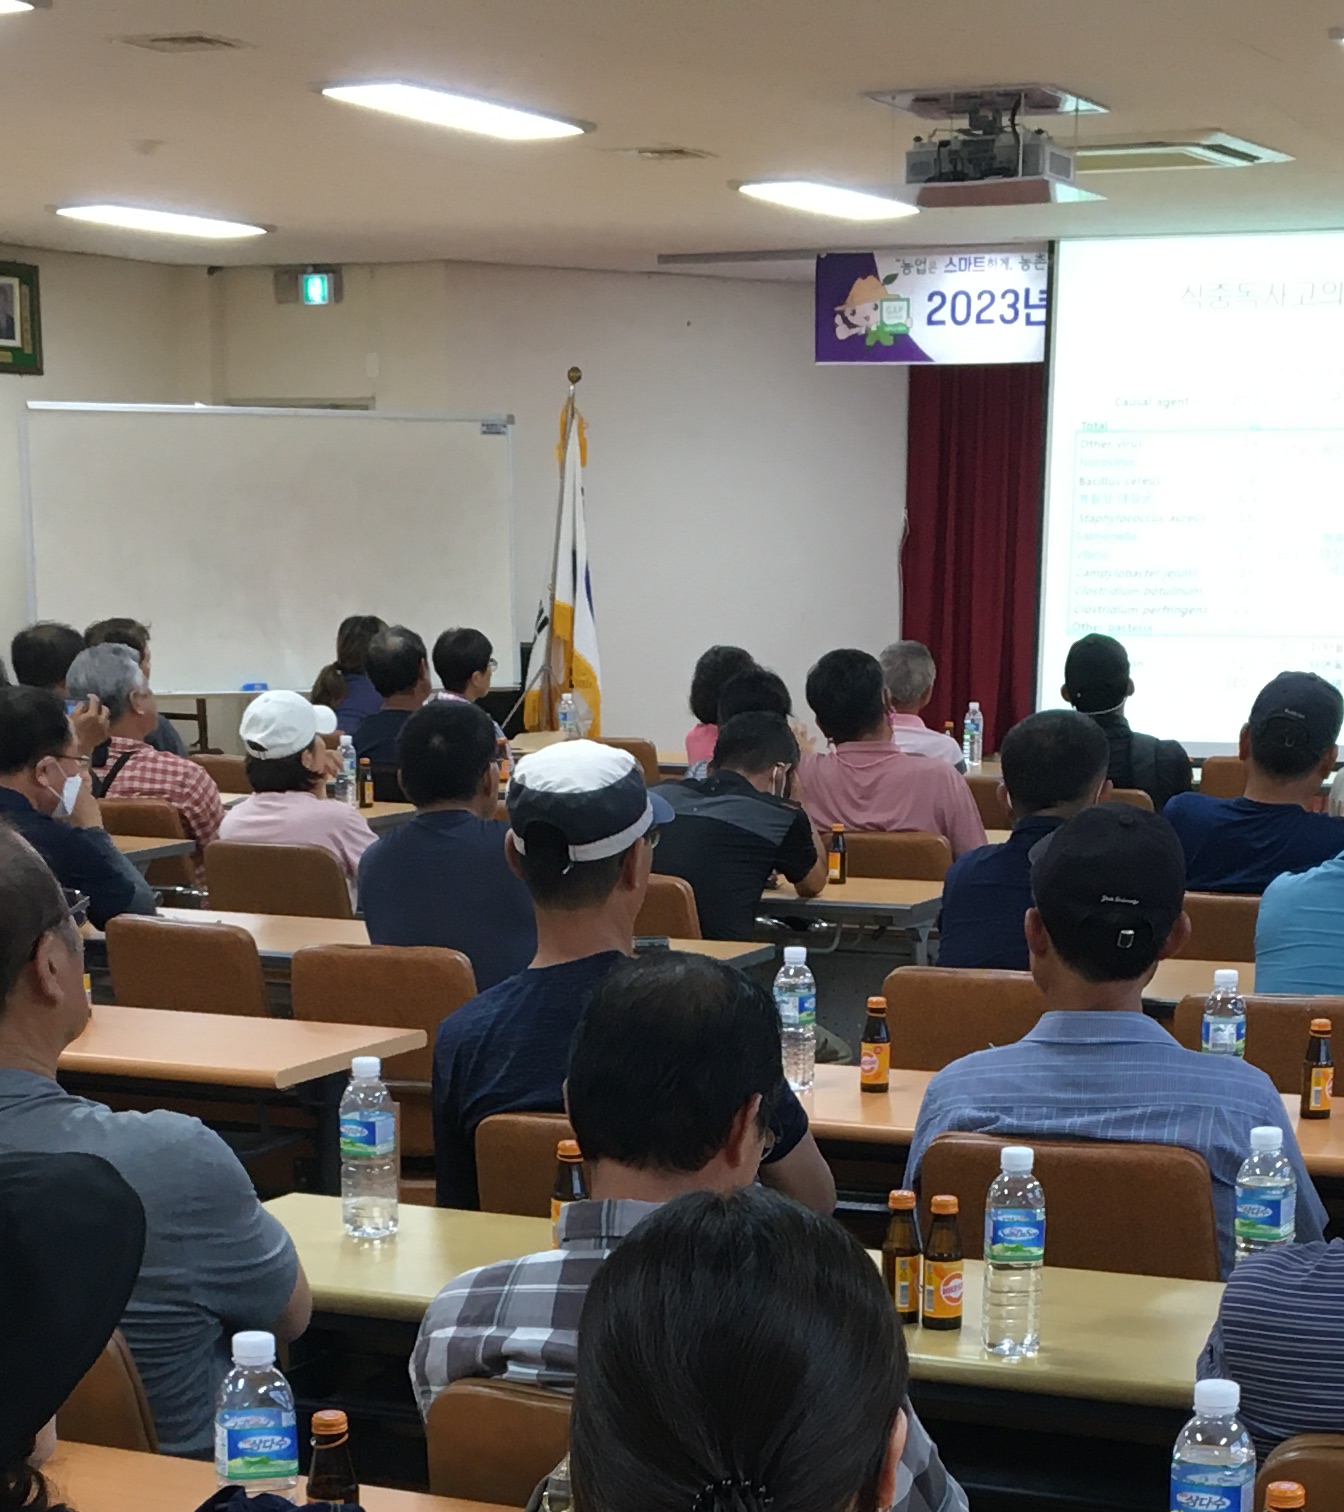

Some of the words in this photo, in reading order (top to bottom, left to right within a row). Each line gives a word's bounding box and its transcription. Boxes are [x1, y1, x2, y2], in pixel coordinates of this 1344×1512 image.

[1181, 279, 1344, 311] 식중독사고의
[926, 287, 1047, 327] 2023년
[1080, 439, 1111, 449] Other
[249, 1437, 288, 1451] 삼다수
[1185, 1494, 1227, 1509] 삼다수
